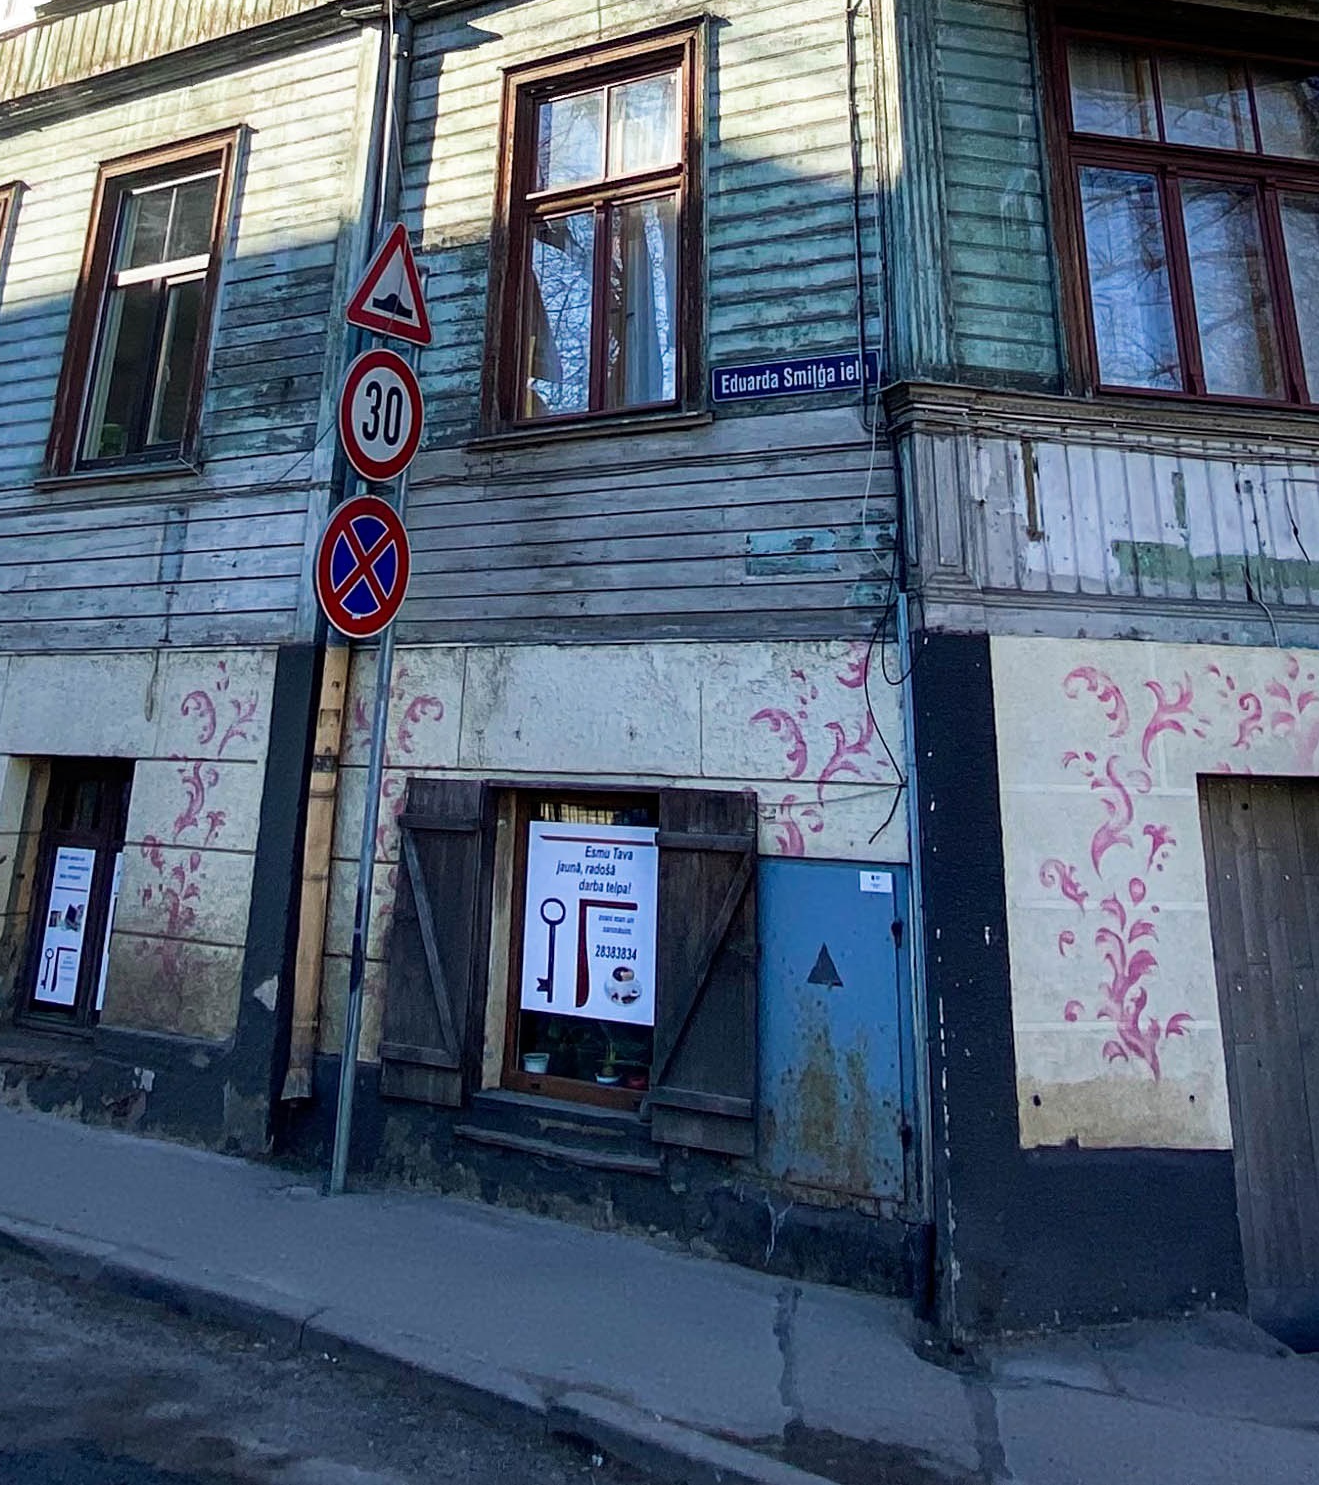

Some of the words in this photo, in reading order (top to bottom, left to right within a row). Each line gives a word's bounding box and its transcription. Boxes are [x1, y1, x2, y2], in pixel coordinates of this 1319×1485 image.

[721, 370, 779, 394] Eduarda
[783, 363, 835, 389] Smiļģa
[362, 380, 403, 447] 30
[584, 845, 611, 859] Esmu
[613, 847, 634, 861] Tava
[555, 860, 583, 876] jaunā,
[584, 863, 616, 876] radošā
[578, 878, 604, 893] darba
[606, 881, 632, 896] telpa!
[594, 944, 638, 961] 28383834
